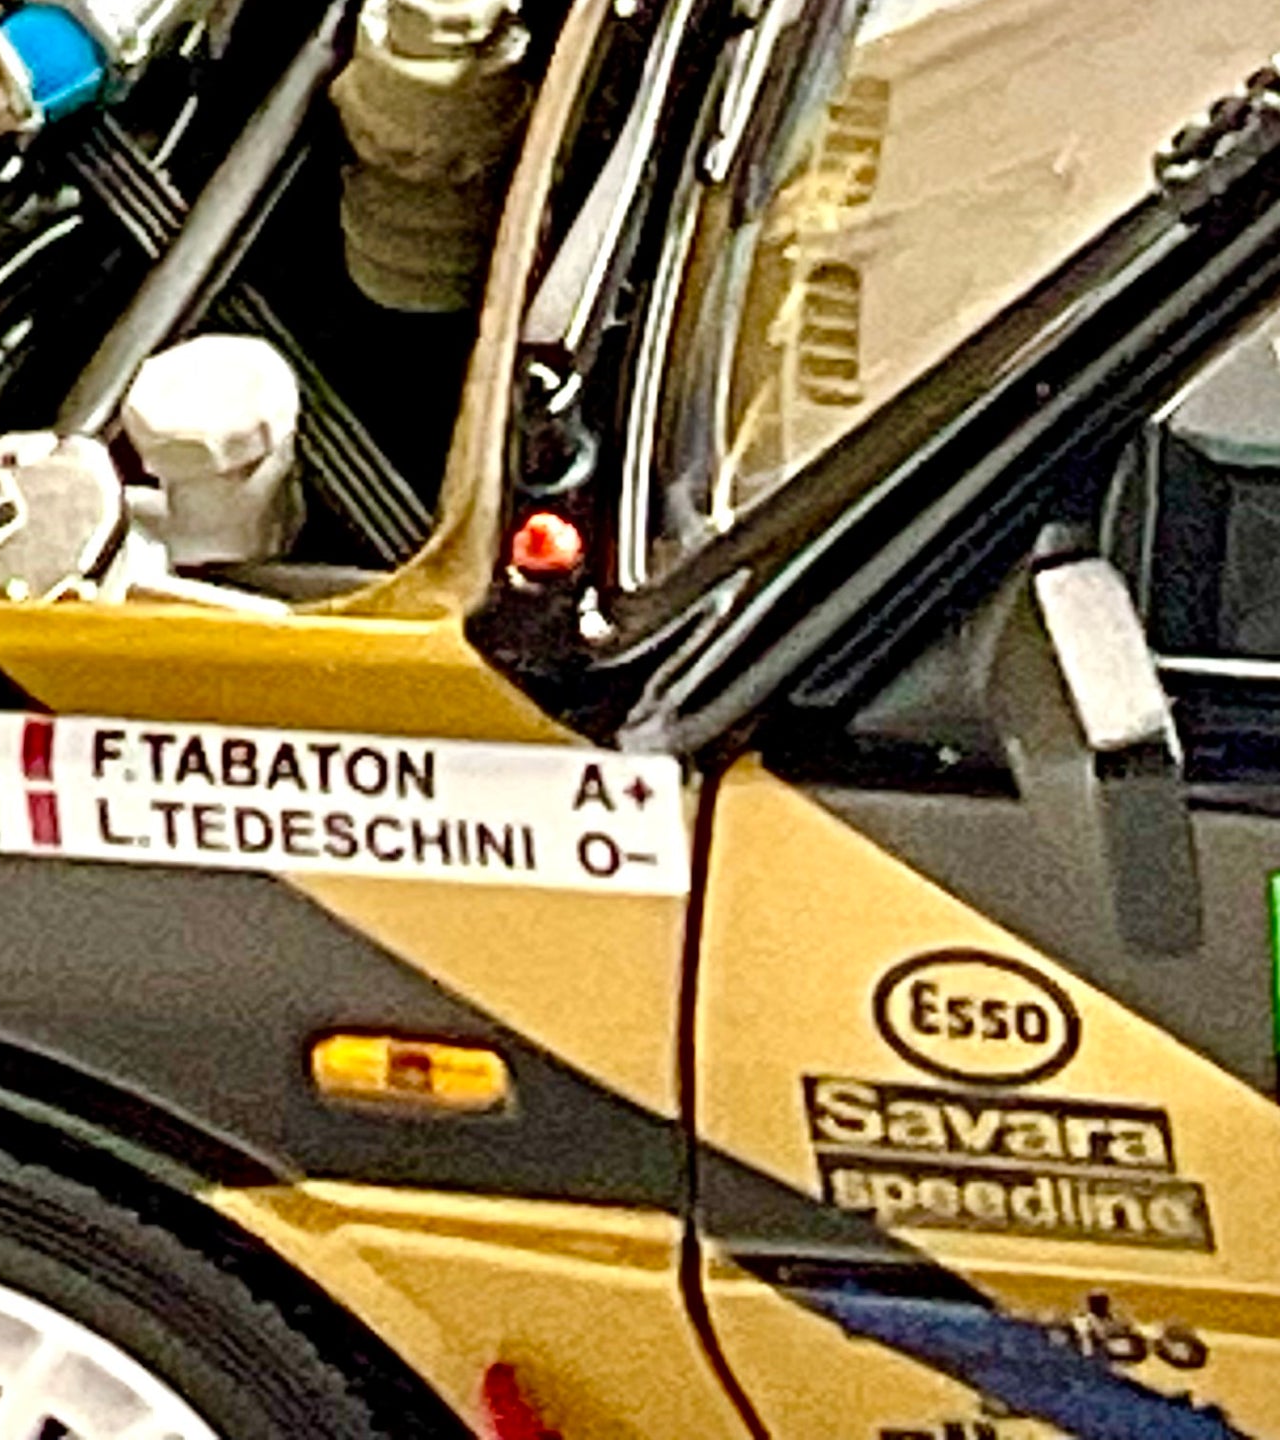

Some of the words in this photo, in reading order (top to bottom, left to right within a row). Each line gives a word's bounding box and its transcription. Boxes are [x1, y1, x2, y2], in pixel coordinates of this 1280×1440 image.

[91, 727, 437, 801] F.TABATON
[572, 763, 656, 812] A+
[96, 796, 539, 871] L.TEDESCHINI
[908, 978, 1051, 1044] Esso
[815, 1081, 1169, 1164] Savara
[829, 1167, 1204, 1237] speedline
